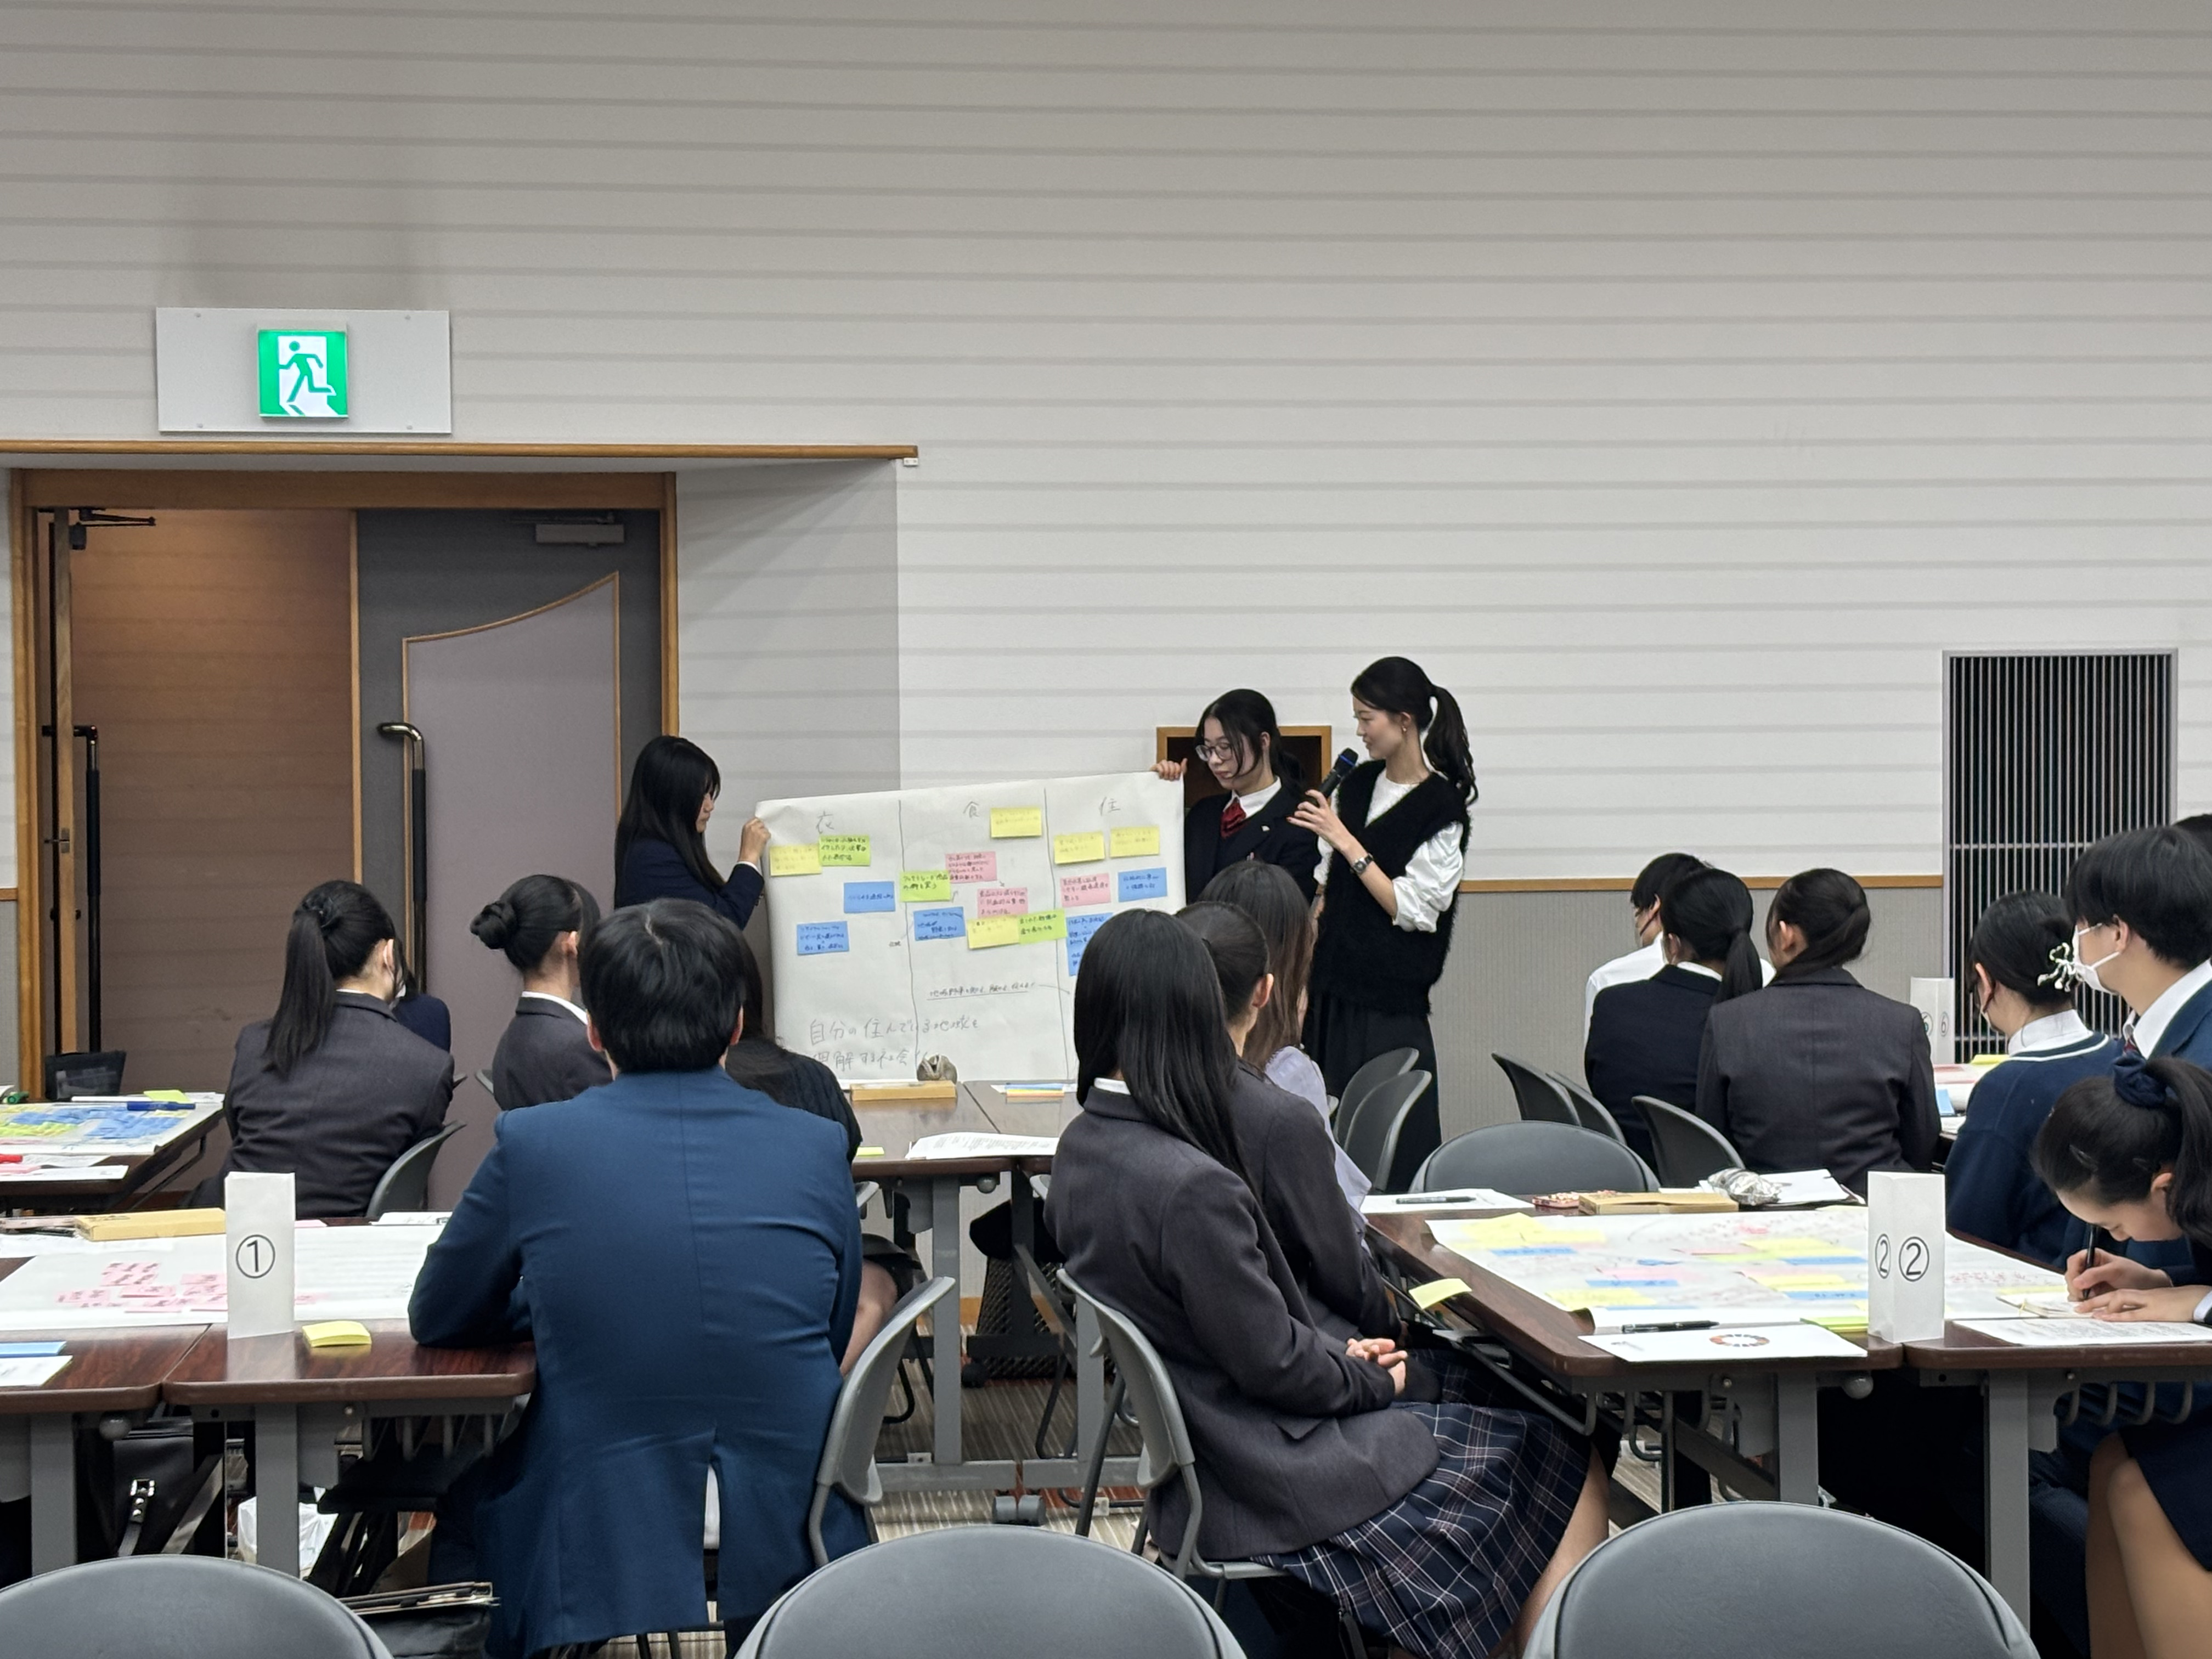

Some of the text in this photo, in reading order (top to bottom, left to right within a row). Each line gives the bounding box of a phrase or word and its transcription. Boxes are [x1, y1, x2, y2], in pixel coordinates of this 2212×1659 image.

[963, 801, 980, 818] 食
[1098, 796, 1121, 817] 住
[816, 809, 834, 834] 衣
[810, 1015, 979, 1046] 自分の住んでいる地域を
